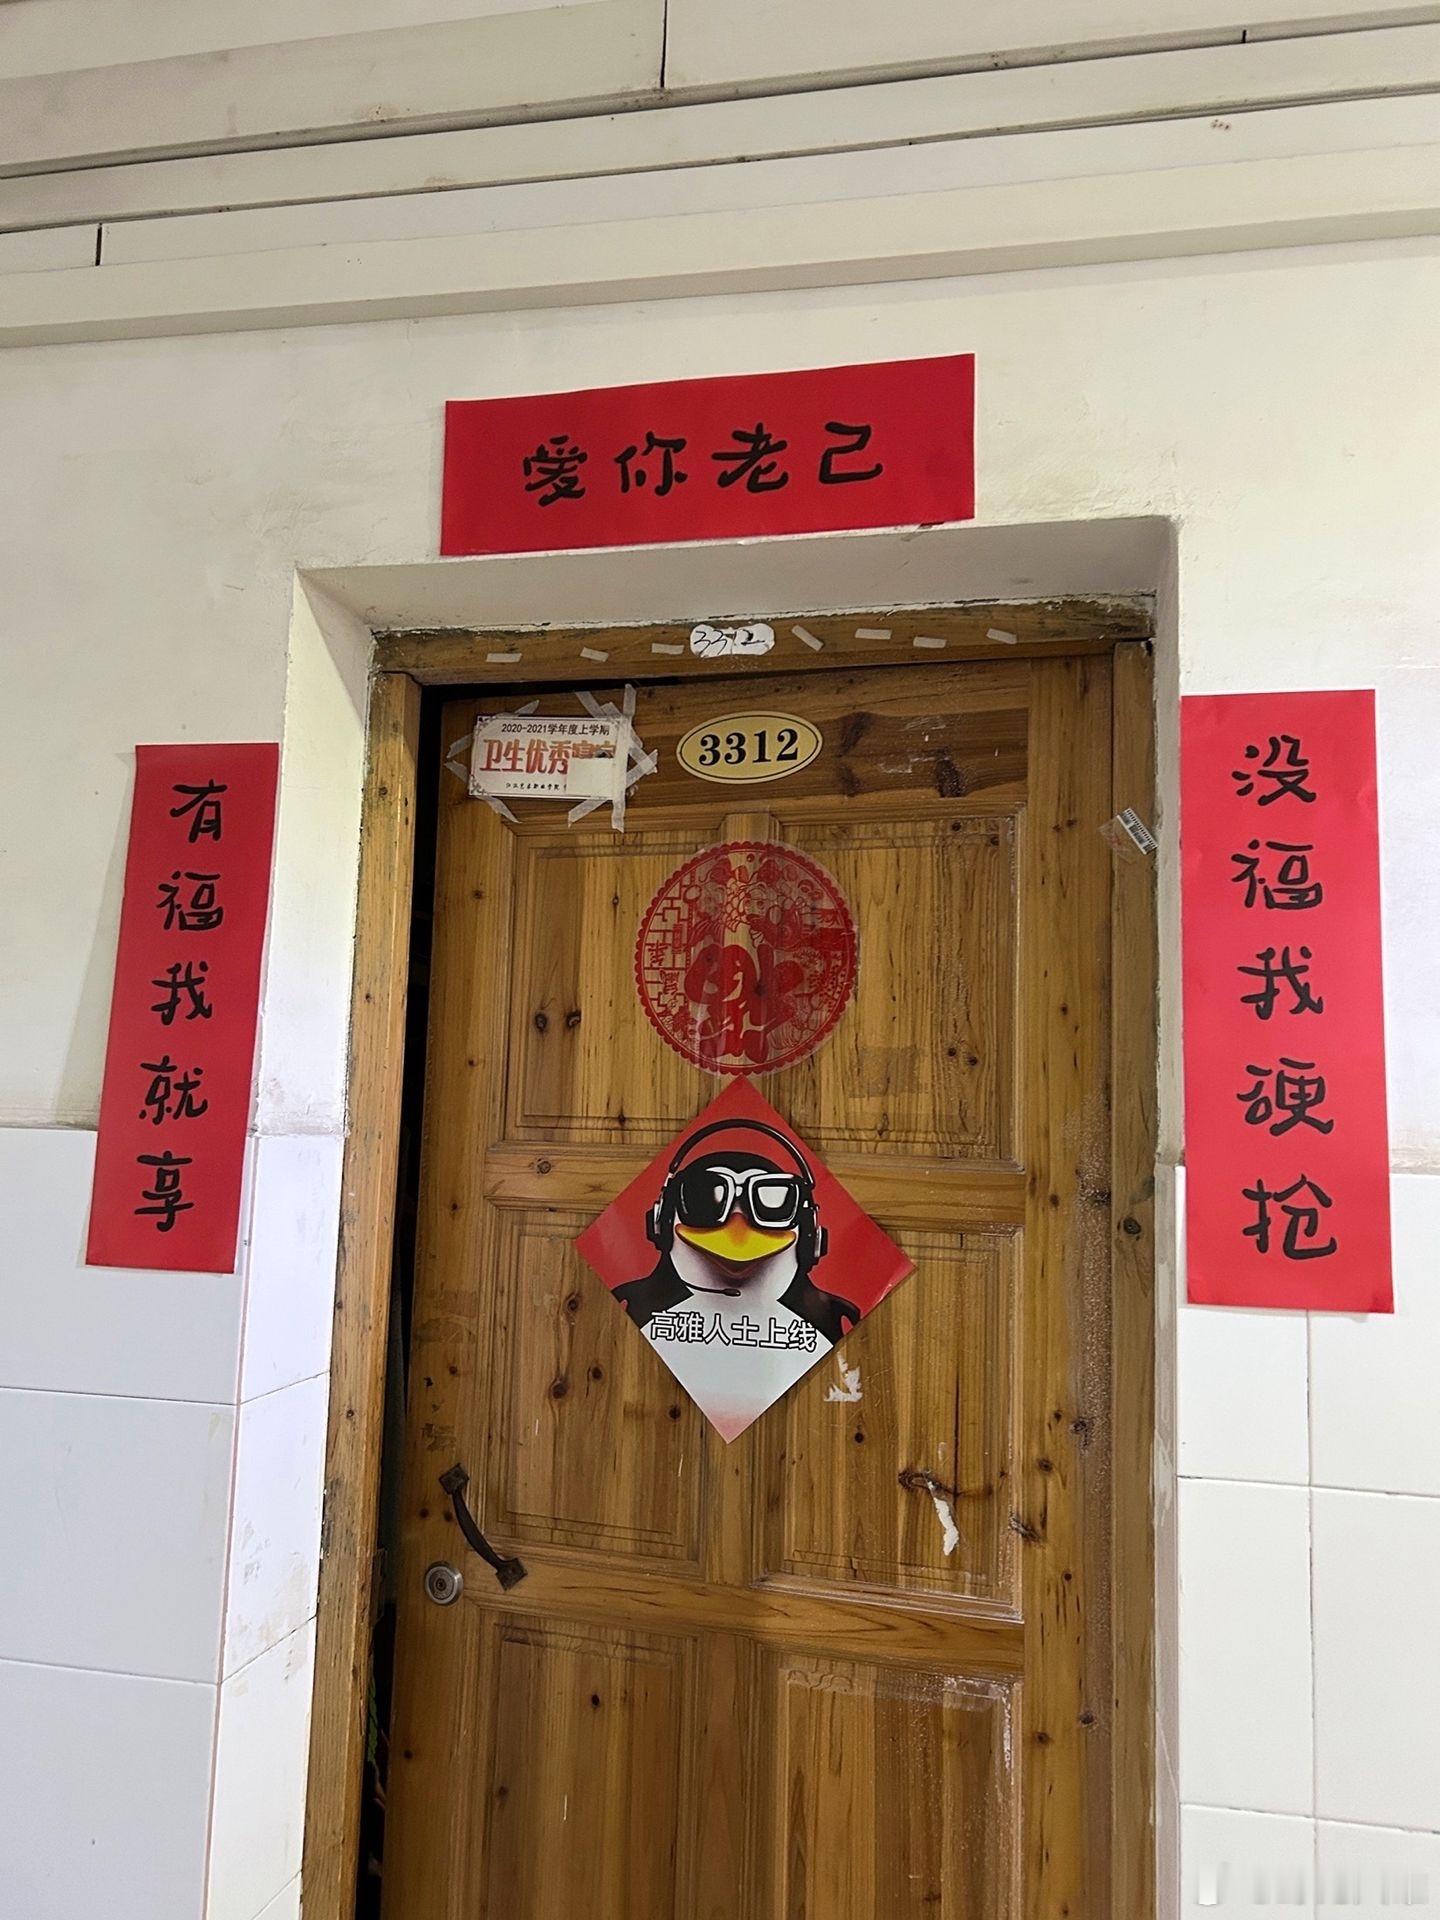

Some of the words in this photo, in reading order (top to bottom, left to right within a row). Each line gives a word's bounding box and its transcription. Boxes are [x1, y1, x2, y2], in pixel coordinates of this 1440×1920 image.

[522, 421, 883, 507] 爱你老己
[501, 723, 610, 737] 2020-2021学年度上学期
[698, 728, 798, 767] 3312
[134, 779, 228, 1232] 有福我就享
[1231, 734, 1337, 1260] 没福我硬抢
[651, 1311, 817, 1351] 高雅人士上线
